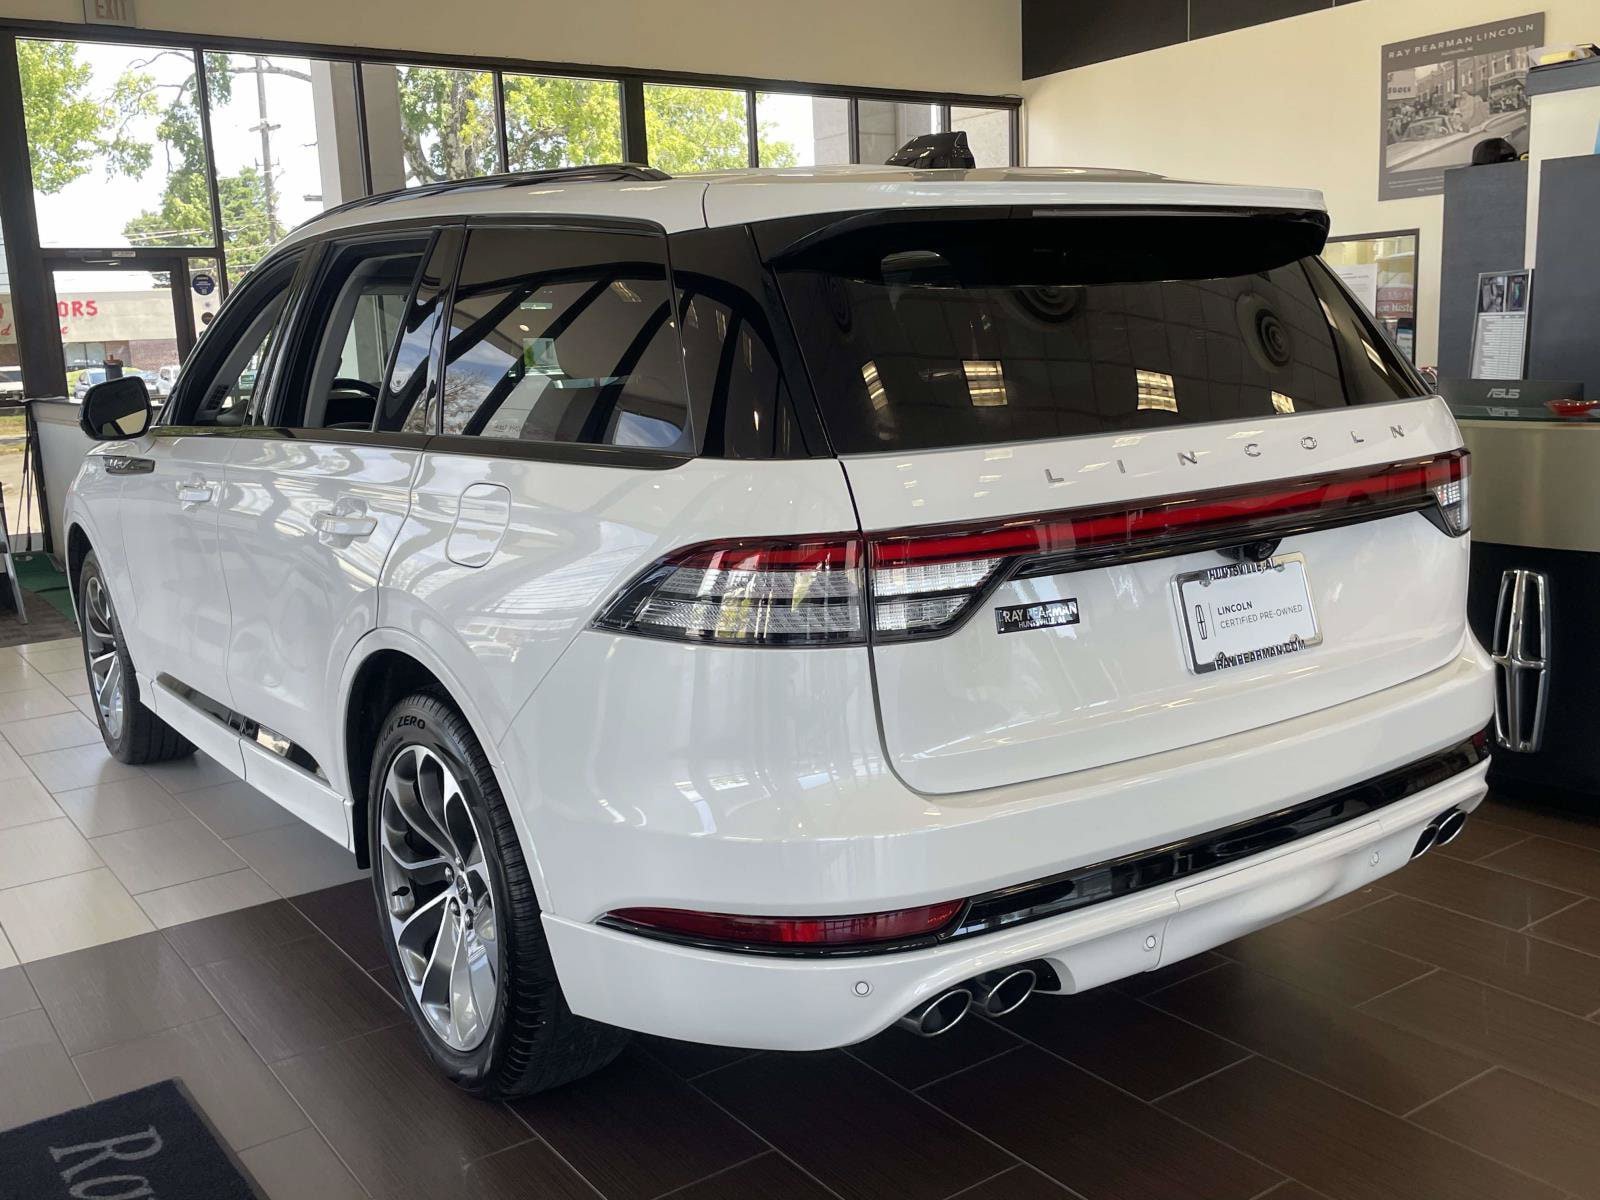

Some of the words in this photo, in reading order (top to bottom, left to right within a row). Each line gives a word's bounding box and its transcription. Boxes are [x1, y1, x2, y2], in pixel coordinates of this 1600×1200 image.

[95, 0, 127, 21] EXIT
[1388, 48, 1411, 59] RAY
[1414, 36, 1473, 54] PEARMAN
[1476, 23, 1534, 42] LINCOLN
[1486, 388, 1520, 399] ASUS
[1045, 424, 1405, 484] LINCOLN
[1003, 609, 1024, 623] RAY
[1026, 601, 1077, 620] PEARMAN
[1217, 601, 1253, 615] LINCOLN
[1220, 613, 1258, 629] CERTIFIED
[1260, 604, 1303, 620] PRE-OWNED
[397, 714, 426, 729] ZERO
